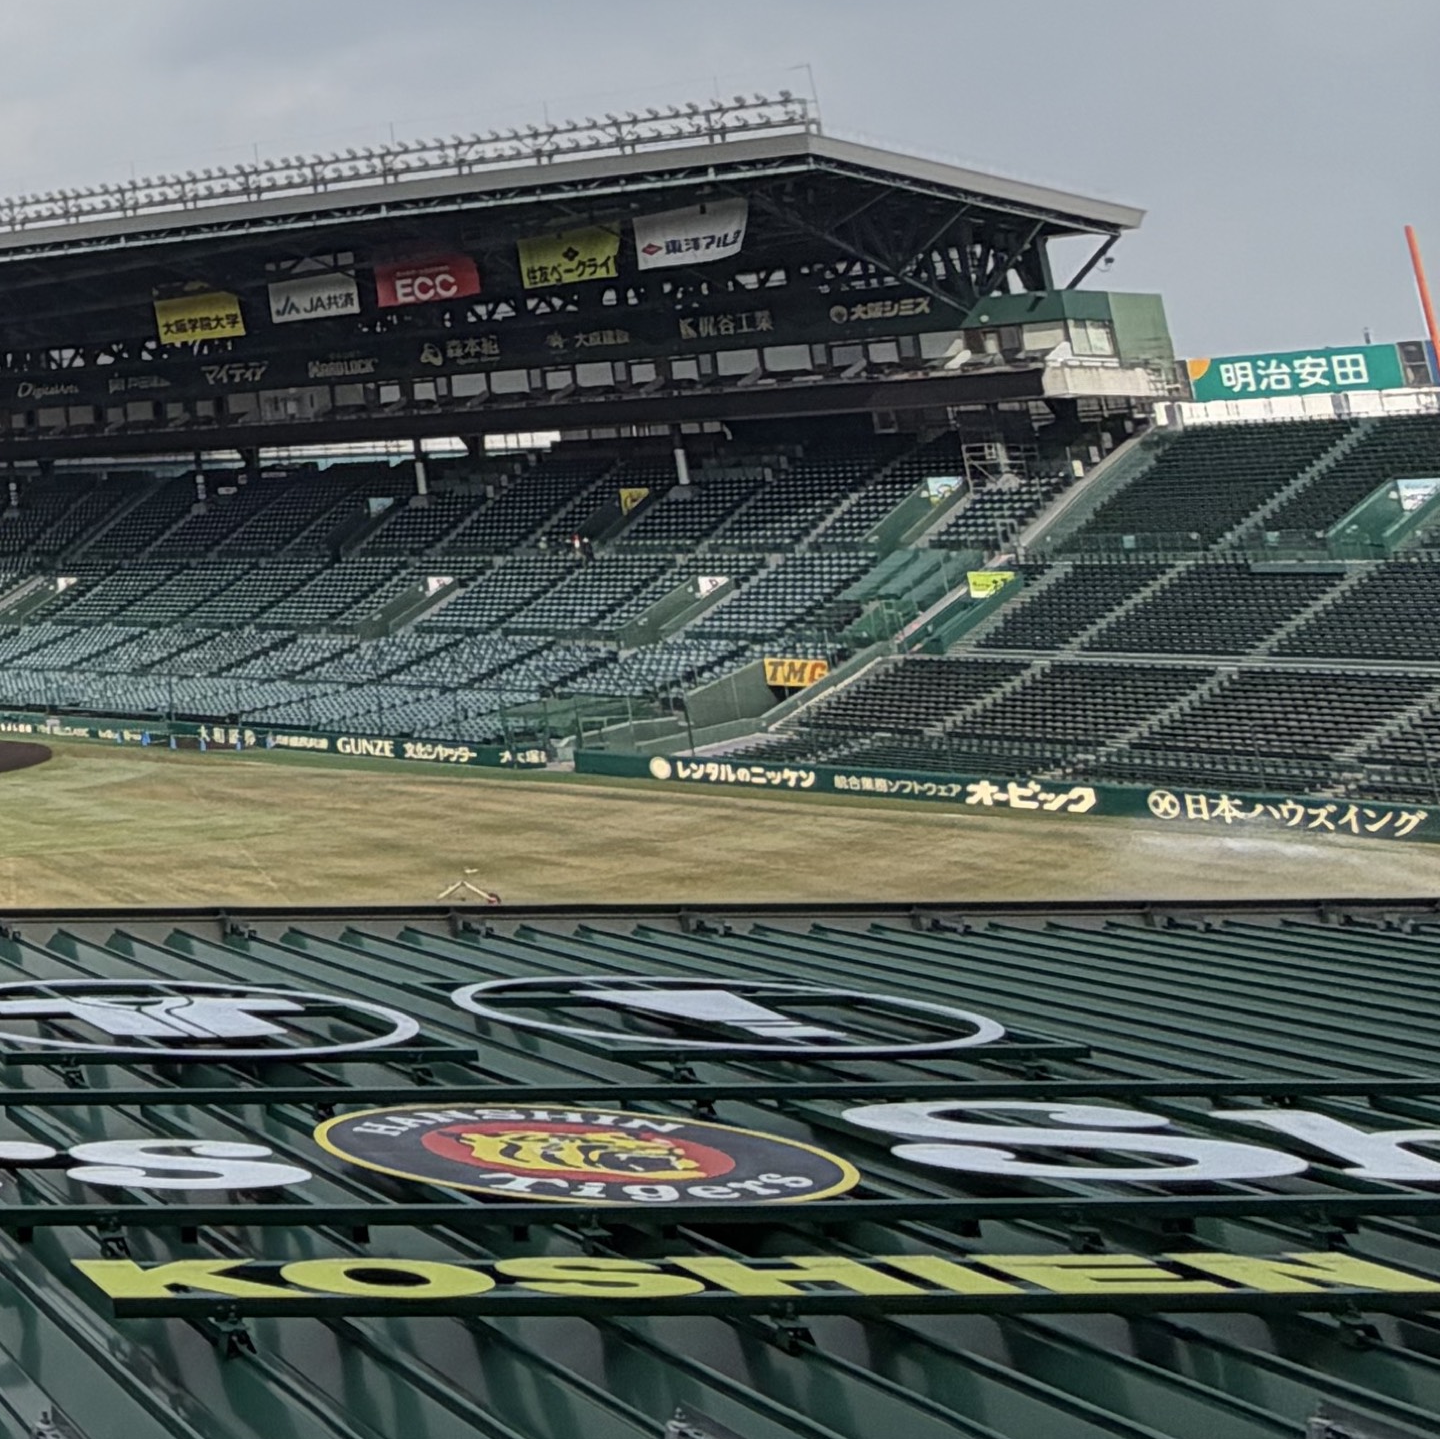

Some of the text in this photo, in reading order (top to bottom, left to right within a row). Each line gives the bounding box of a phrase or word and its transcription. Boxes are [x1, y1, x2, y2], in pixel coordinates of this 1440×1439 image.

[395, 274, 458, 303] ECC
[163, 313, 240, 336] 大阪学院大学
[445, 334, 500, 359] 森本組
[1220, 352, 1370, 393] 明治安田
[768, 659, 827, 685] TMG
[336, 736, 396, 759] GUNZE
[676, 759, 816, 789] レンタルのニッケン
[965, 779, 1097, 814] オービック
[1184, 794, 1428, 838] 日本ハウズイング
[351, 1109, 686, 1139] HANSHIN
[477, 1171, 815, 1202] Tigers
[69, 1252, 1440, 1295] KOSHIEN
